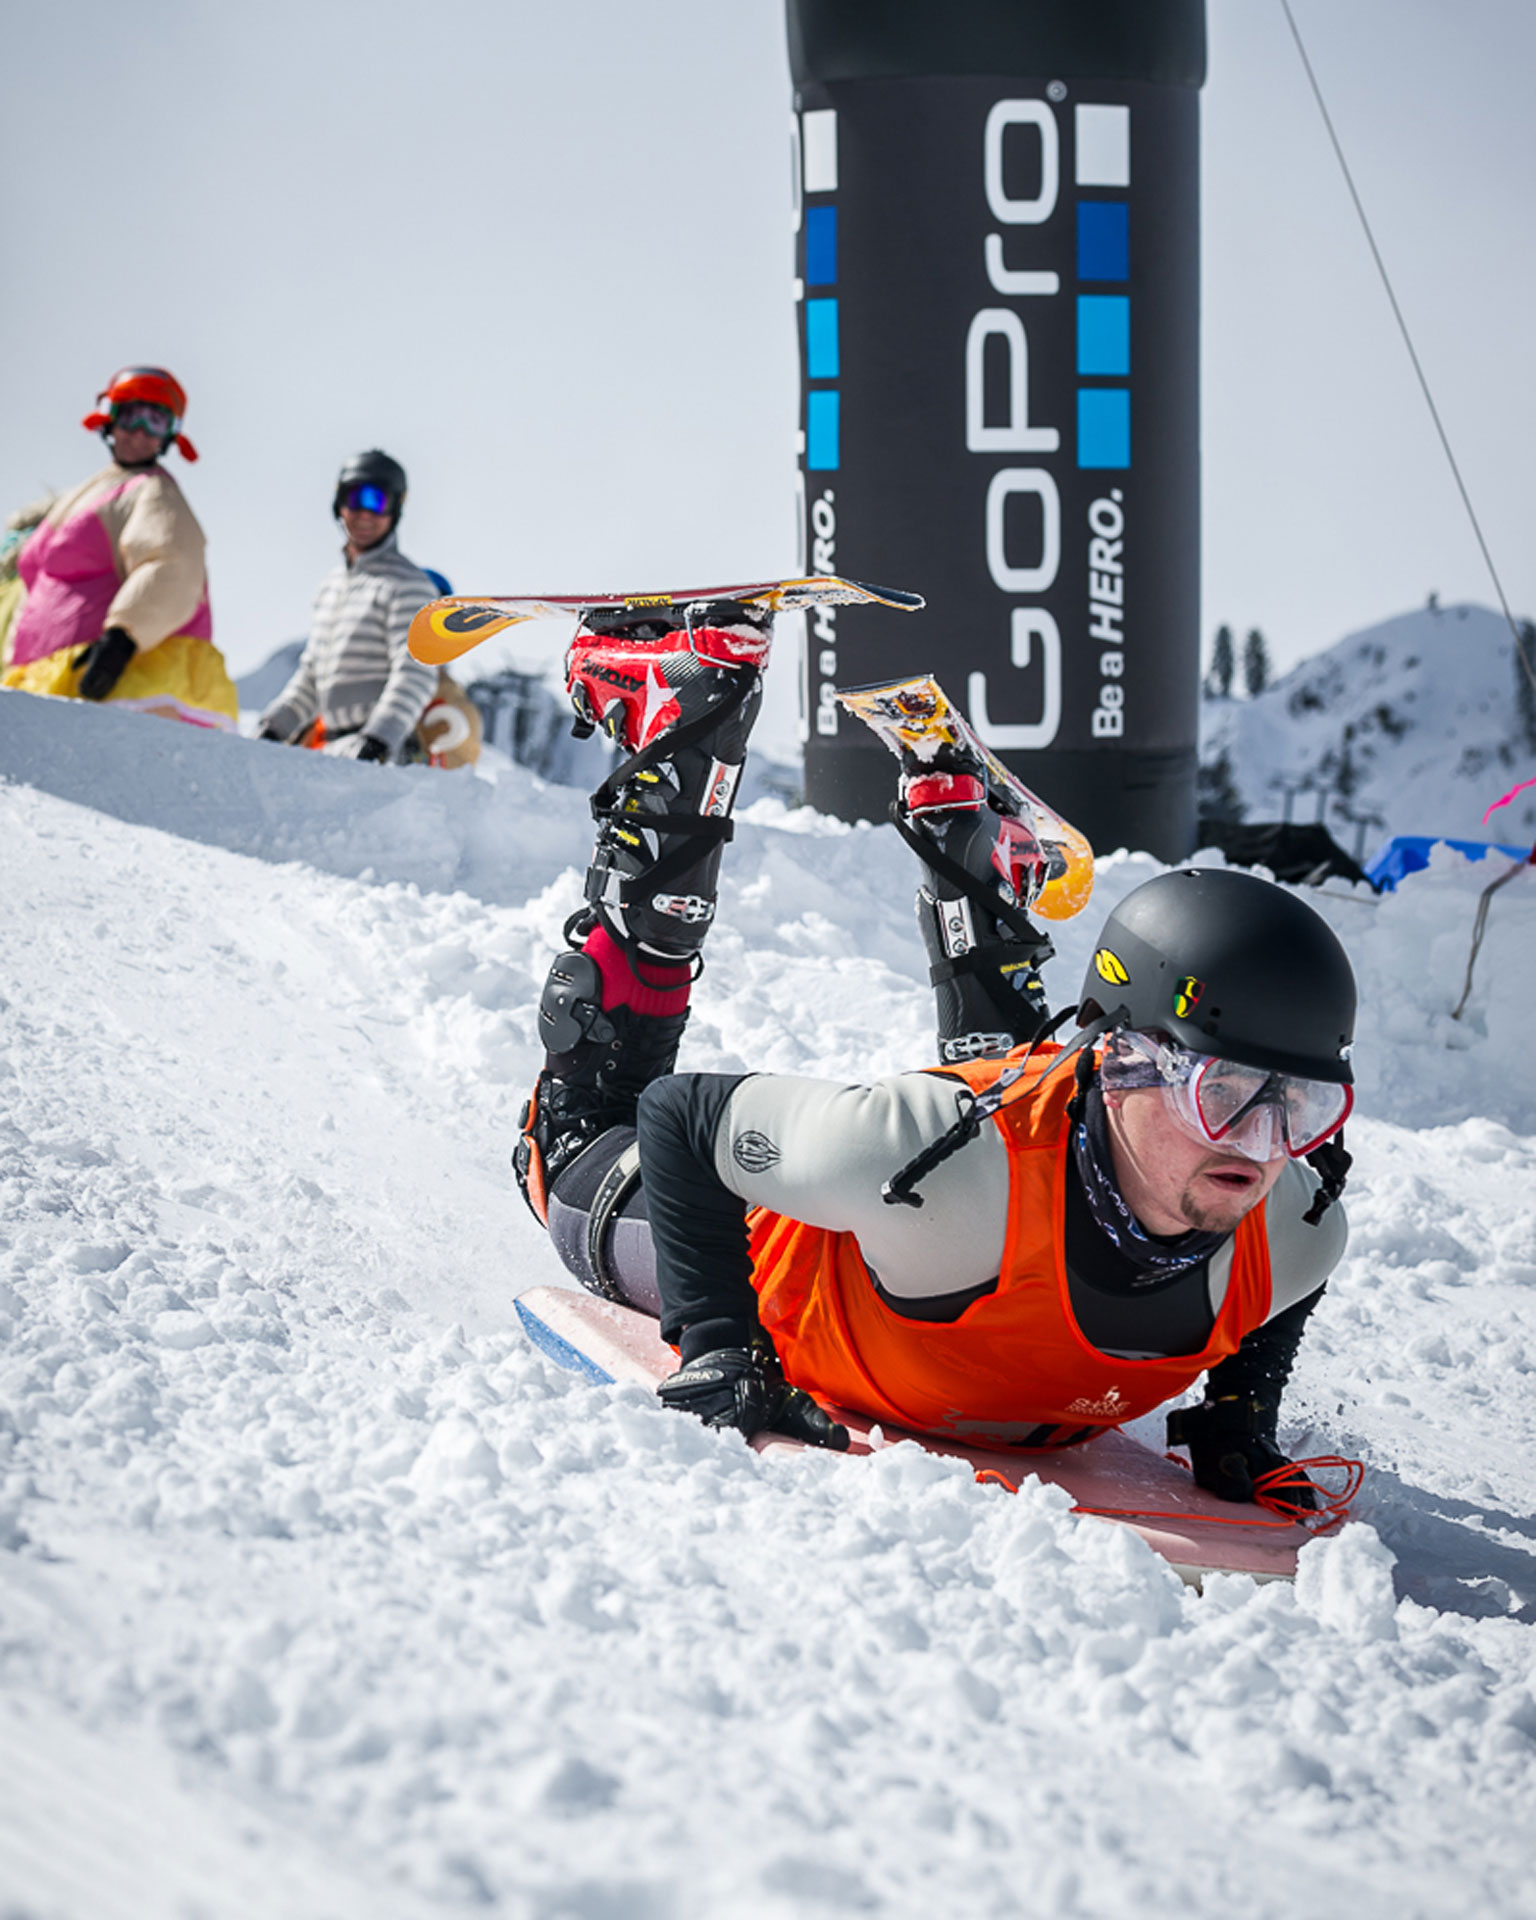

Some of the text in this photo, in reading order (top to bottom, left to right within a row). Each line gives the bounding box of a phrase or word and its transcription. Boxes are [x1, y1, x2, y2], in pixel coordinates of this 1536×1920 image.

[966, 99, 1061, 749] GoPro
[811, 488, 839, 737] Be a HRO.
[1087, 487, 1125, 739] Be a HERO.
